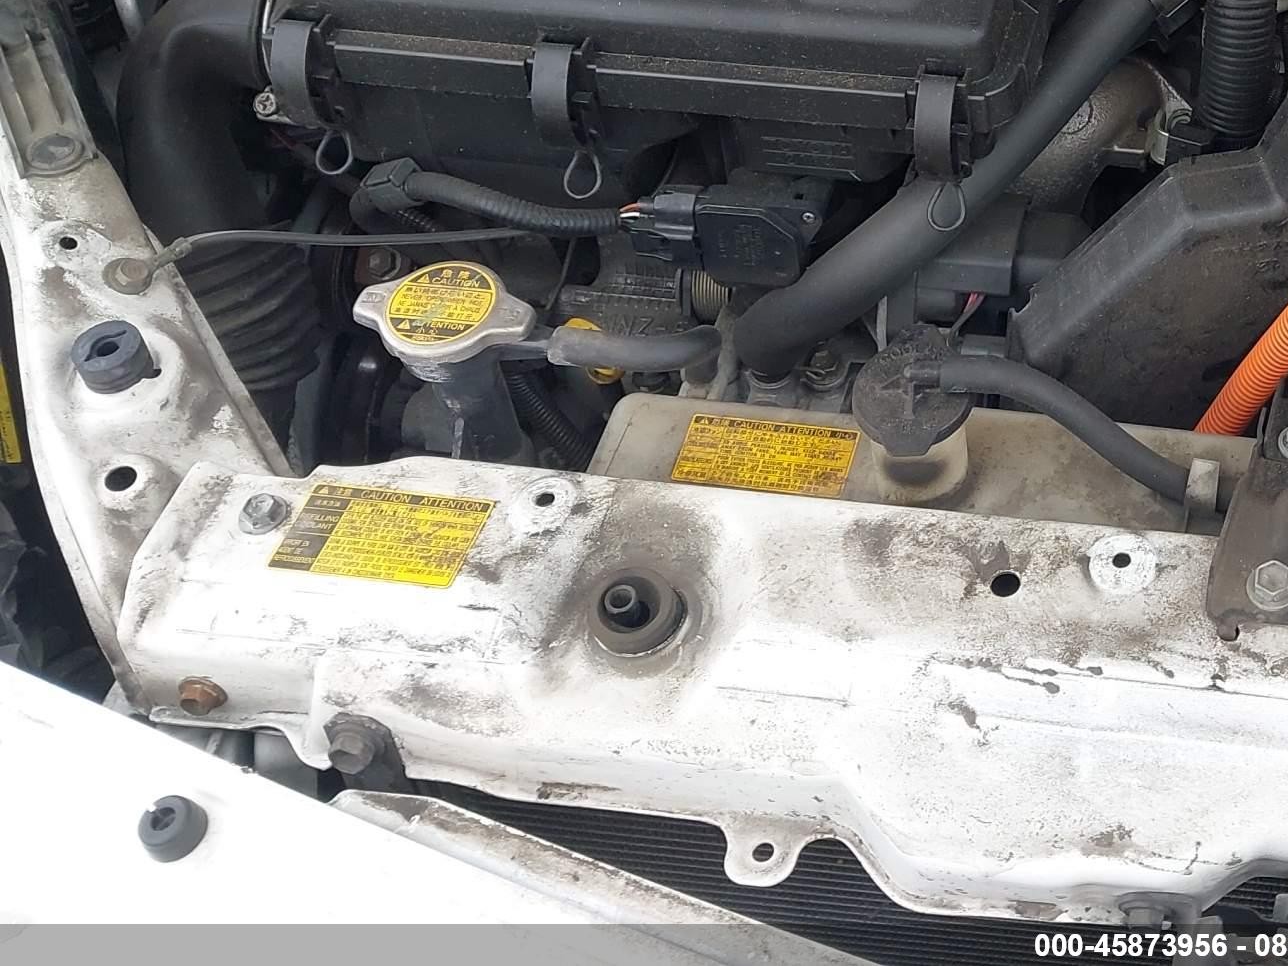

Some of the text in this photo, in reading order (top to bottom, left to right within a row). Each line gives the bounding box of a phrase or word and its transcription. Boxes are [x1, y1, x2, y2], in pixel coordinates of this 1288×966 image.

[432, 277, 481, 288] CAUTION
[734, 420, 775, 432] CAUTION
[780, 425, 832, 438] ATTENTION
[360, 490, 412, 504] CAUTION
[419, 497, 484, 512] ATTENTION
